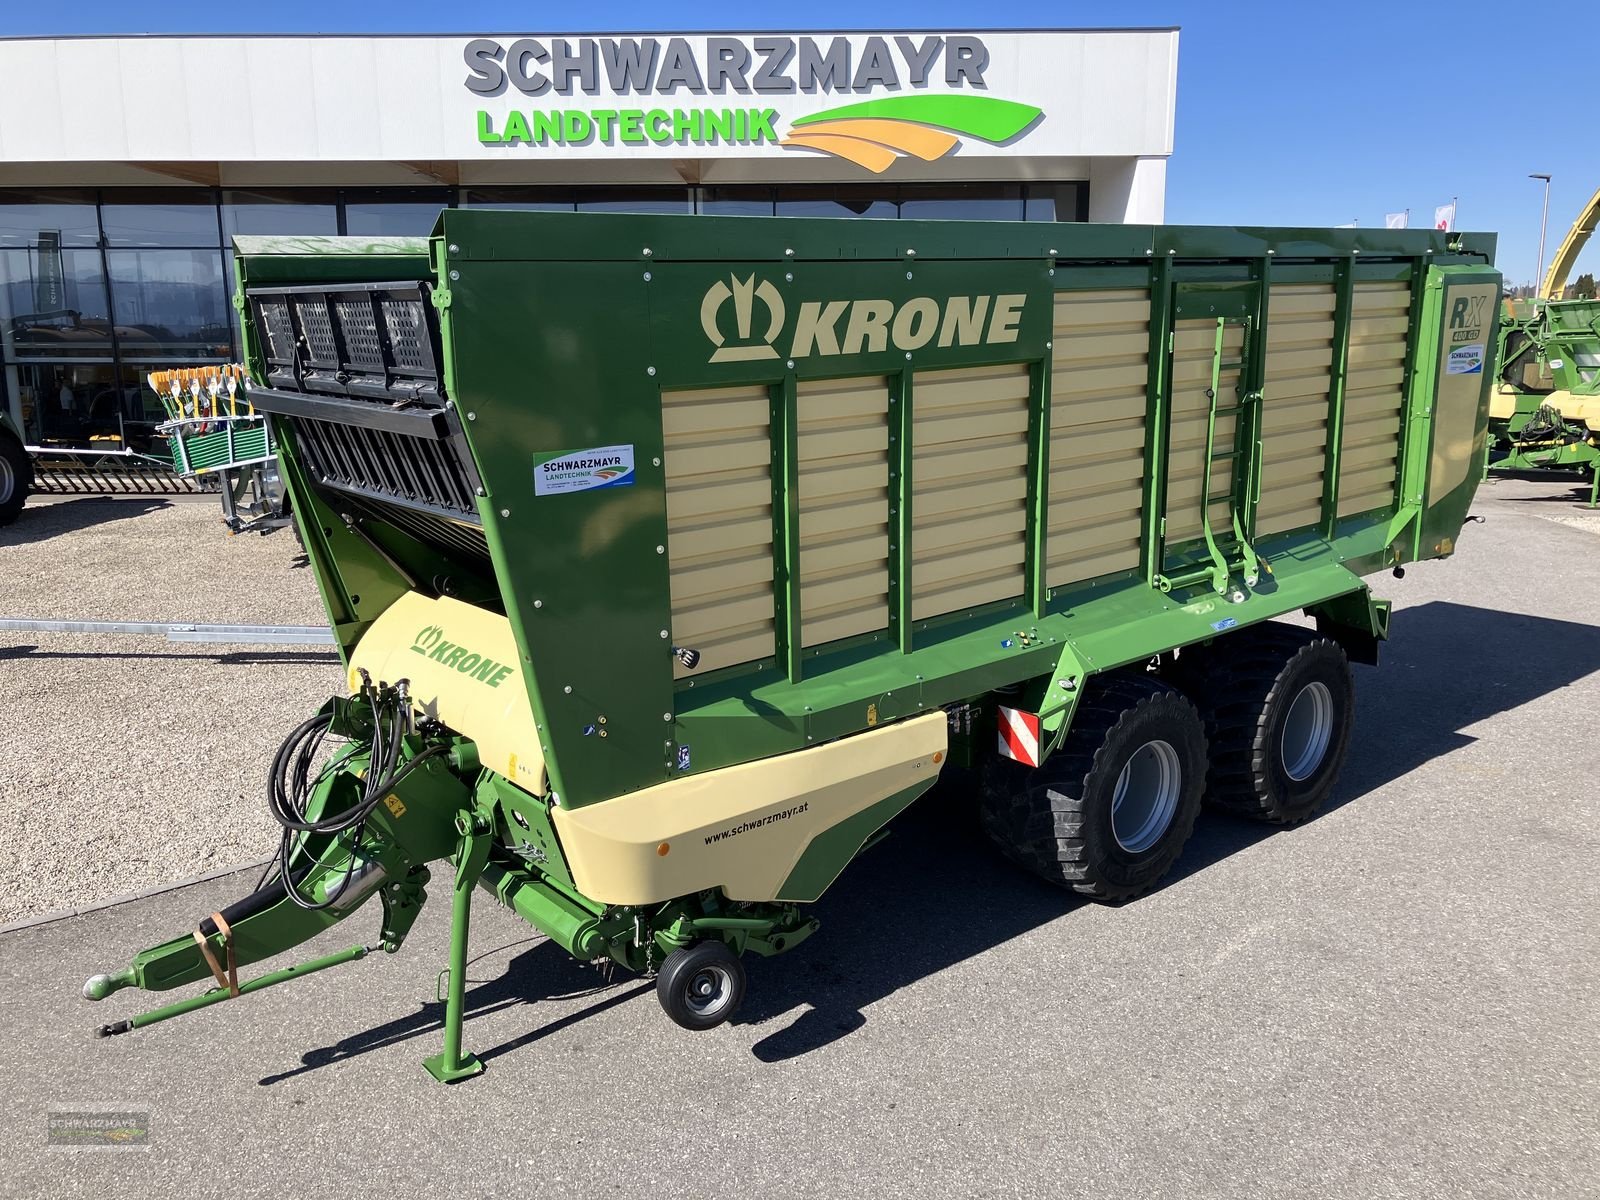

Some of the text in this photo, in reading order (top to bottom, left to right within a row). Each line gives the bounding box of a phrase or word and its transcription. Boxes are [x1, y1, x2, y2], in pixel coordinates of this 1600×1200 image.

[464, 36, 989, 93] SCHWARZMAYR
[477, 108, 779, 143] LANDTECHNIK
[790, 294, 1027, 358] KRONE
[1449, 296, 1487, 329] RX
[1468, 330, 1479, 339] GD
[543, 456, 621, 473] SCHWARZMAYR
[545, 470, 592, 481] LANDTECHNIK
[427, 640, 515, 689] KRONE
[704, 801, 809, 846] www.schwarzmayr.at
